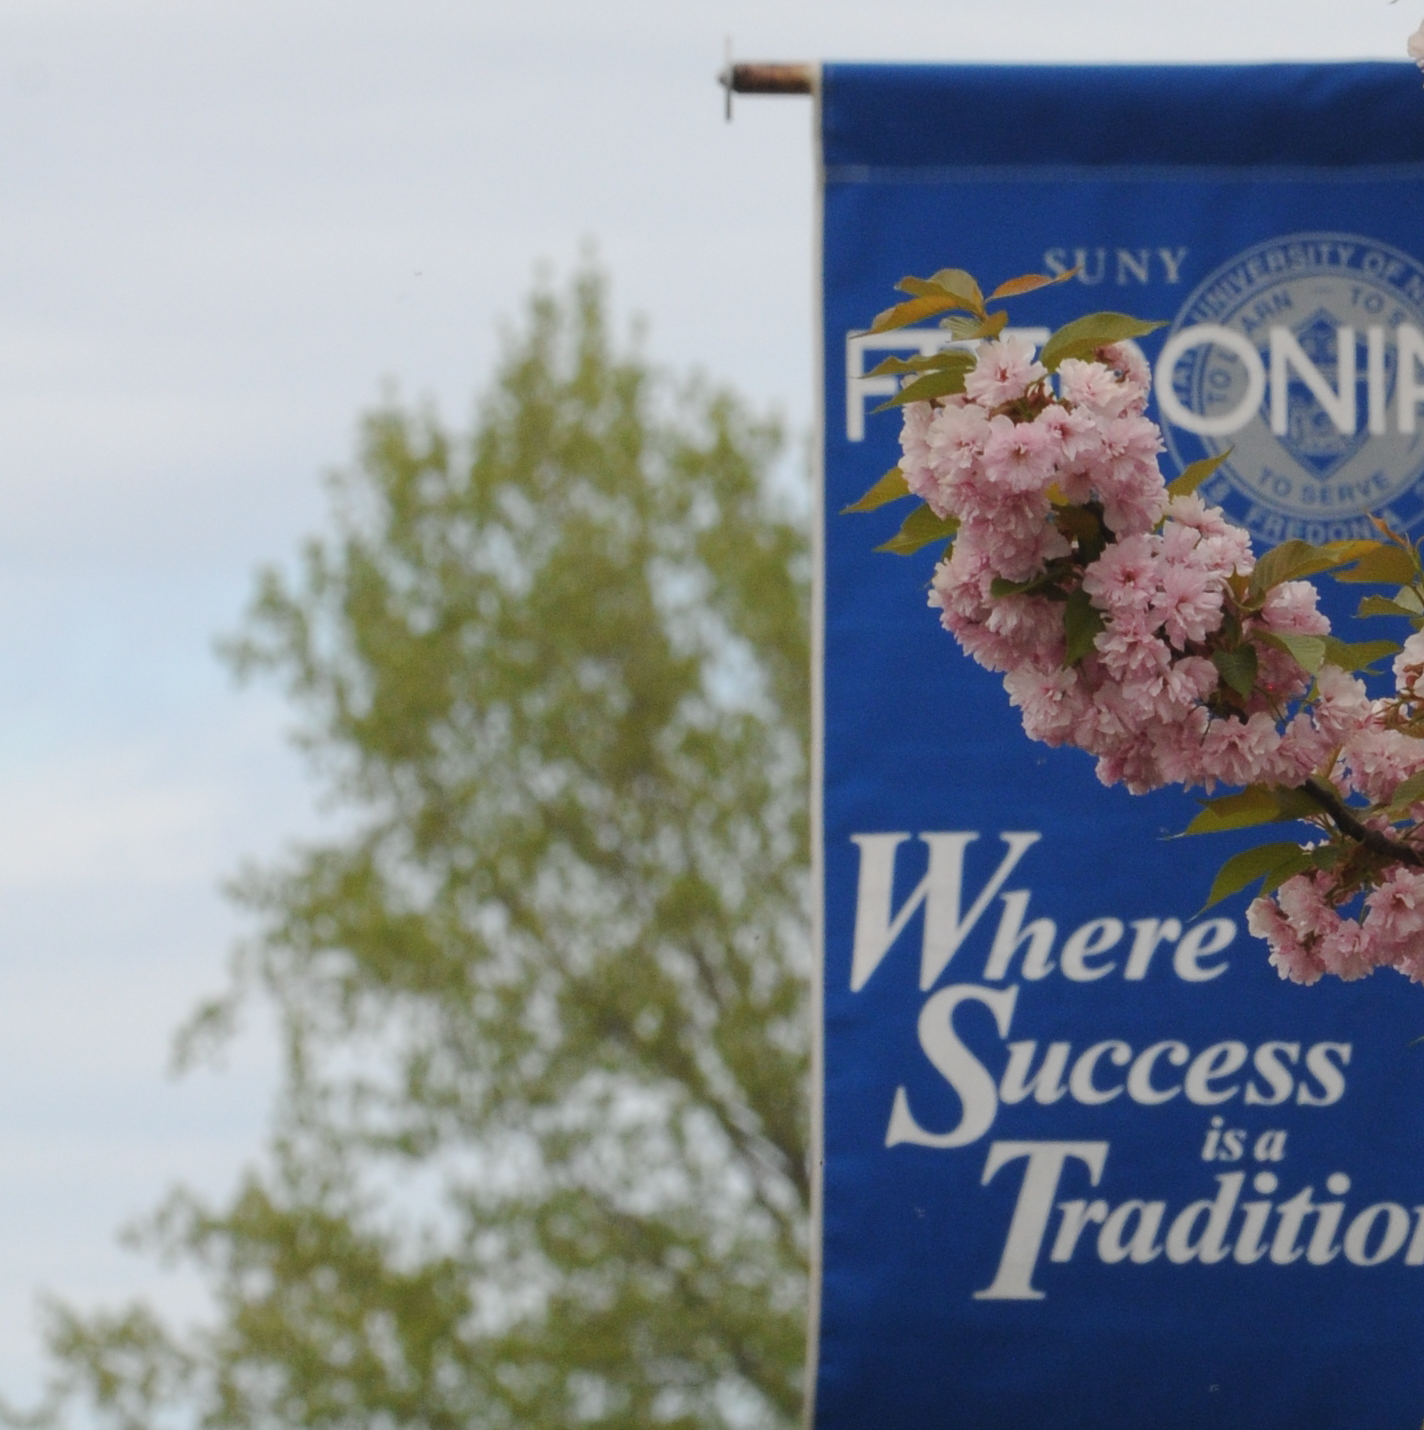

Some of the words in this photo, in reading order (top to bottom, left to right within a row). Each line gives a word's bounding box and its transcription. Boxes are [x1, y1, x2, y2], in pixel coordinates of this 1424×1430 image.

[1044, 247, 1188, 285] SUNY
[1362, 250, 1404, 280] OF
[849, 831, 1238, 993] Where
[884, 983, 1352, 1149] Success
[1201, 1116, 1245, 1162] is
[1252, 1126, 1288, 1162] a
